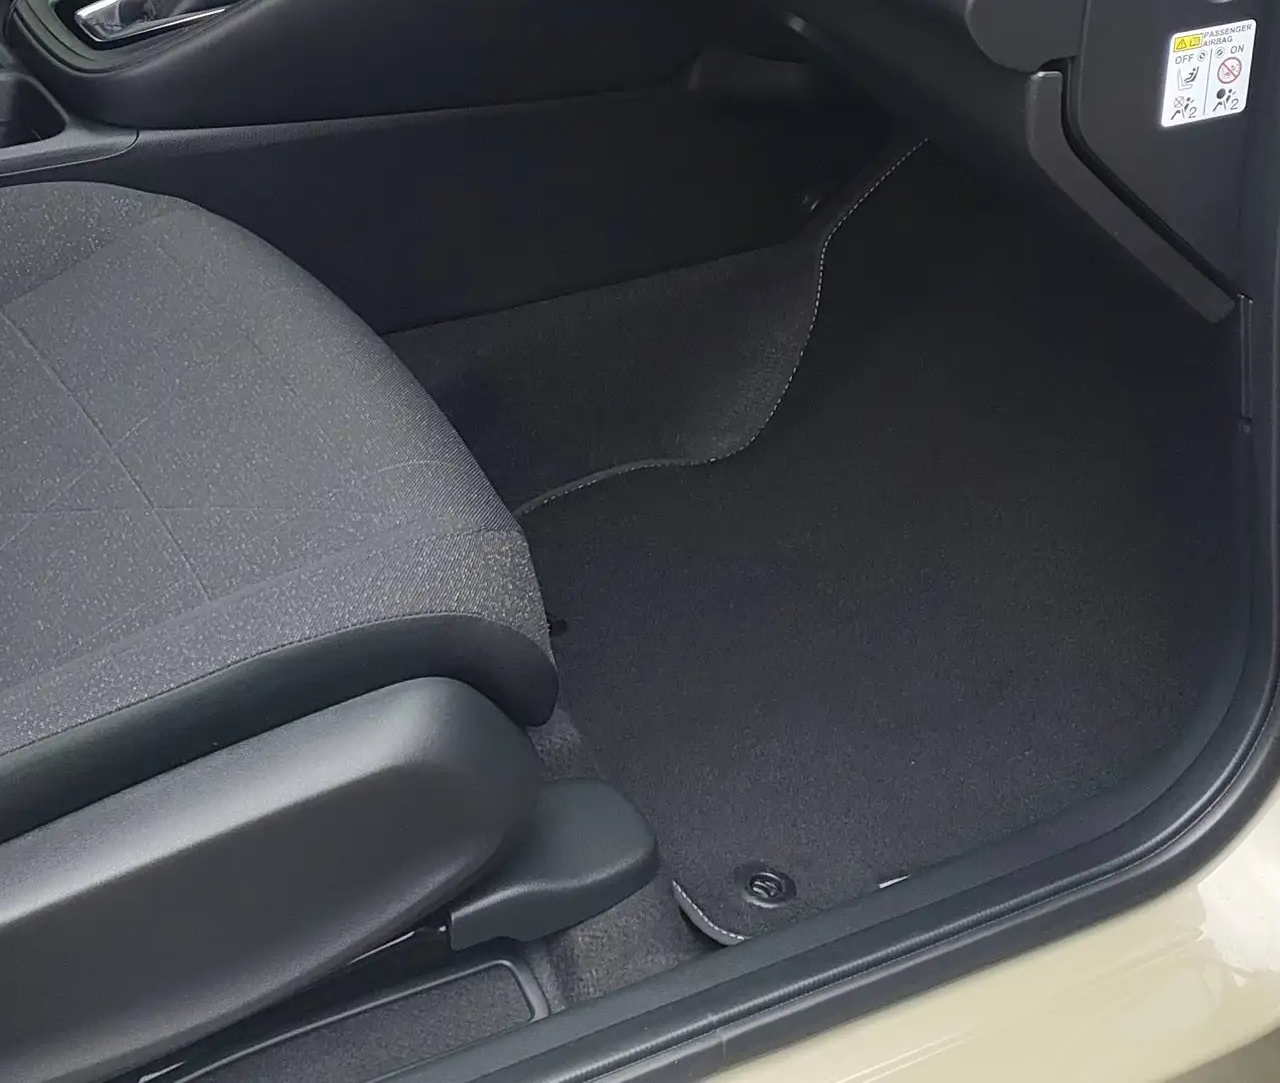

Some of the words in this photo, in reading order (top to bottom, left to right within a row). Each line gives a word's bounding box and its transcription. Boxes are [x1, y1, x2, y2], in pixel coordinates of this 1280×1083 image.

[1203, 24, 1252, 39] PASSENGER
[1203, 35, 1233, 47] AIRBAG
[1230, 44, 1245, 54] ON
[1175, 53, 1195, 65] OFF
